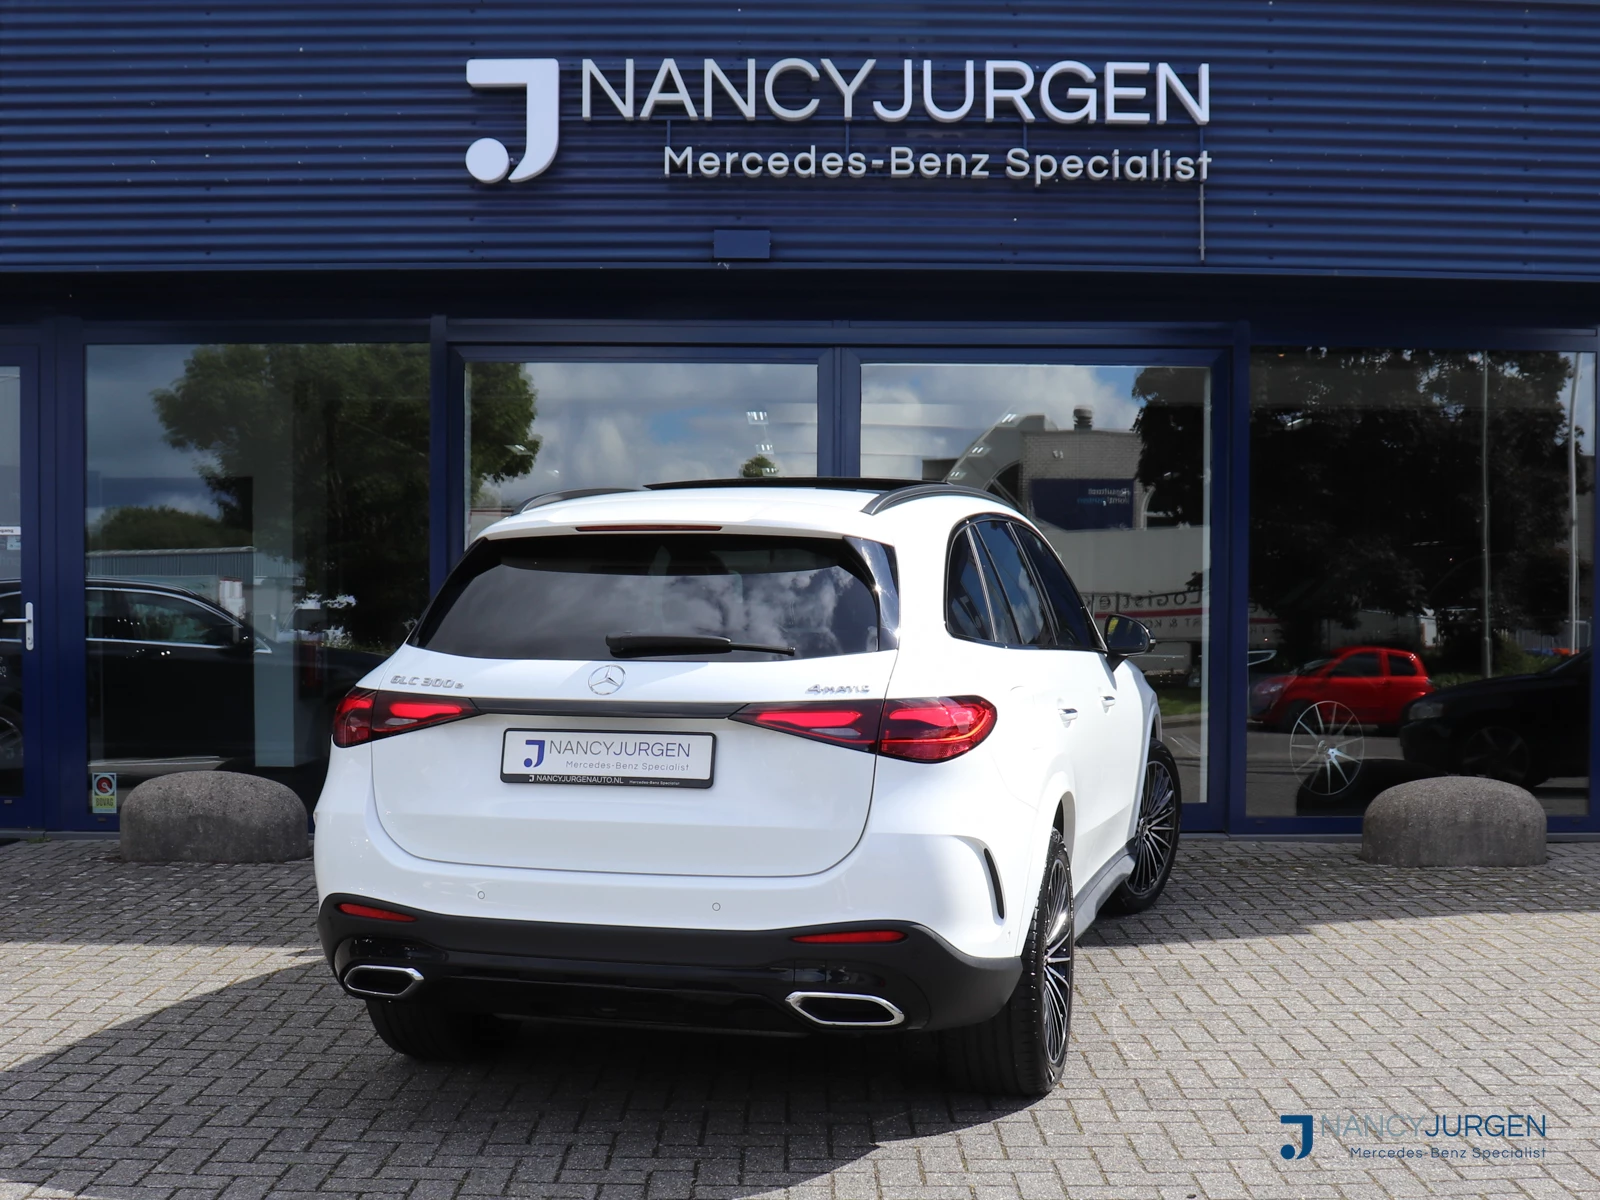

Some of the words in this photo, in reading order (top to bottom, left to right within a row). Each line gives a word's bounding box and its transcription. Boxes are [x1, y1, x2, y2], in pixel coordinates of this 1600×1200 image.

[581, 57, 1211, 126] NANCYJURGEN
[663, 144, 990, 178] Mercedes-Benz
[1005, 147, 1213, 187] Specialist
[391, 675, 419, 686] GLC
[549, 739, 691, 758] NANCYJURGEN
[565, 760, 639, 771] Mercedes-Benz
[641, 762, 690, 772] Specialist
[536, 774, 624, 784] NANCYJURGENAUTO.NL
[96, 797, 113, 806] BOVAG
